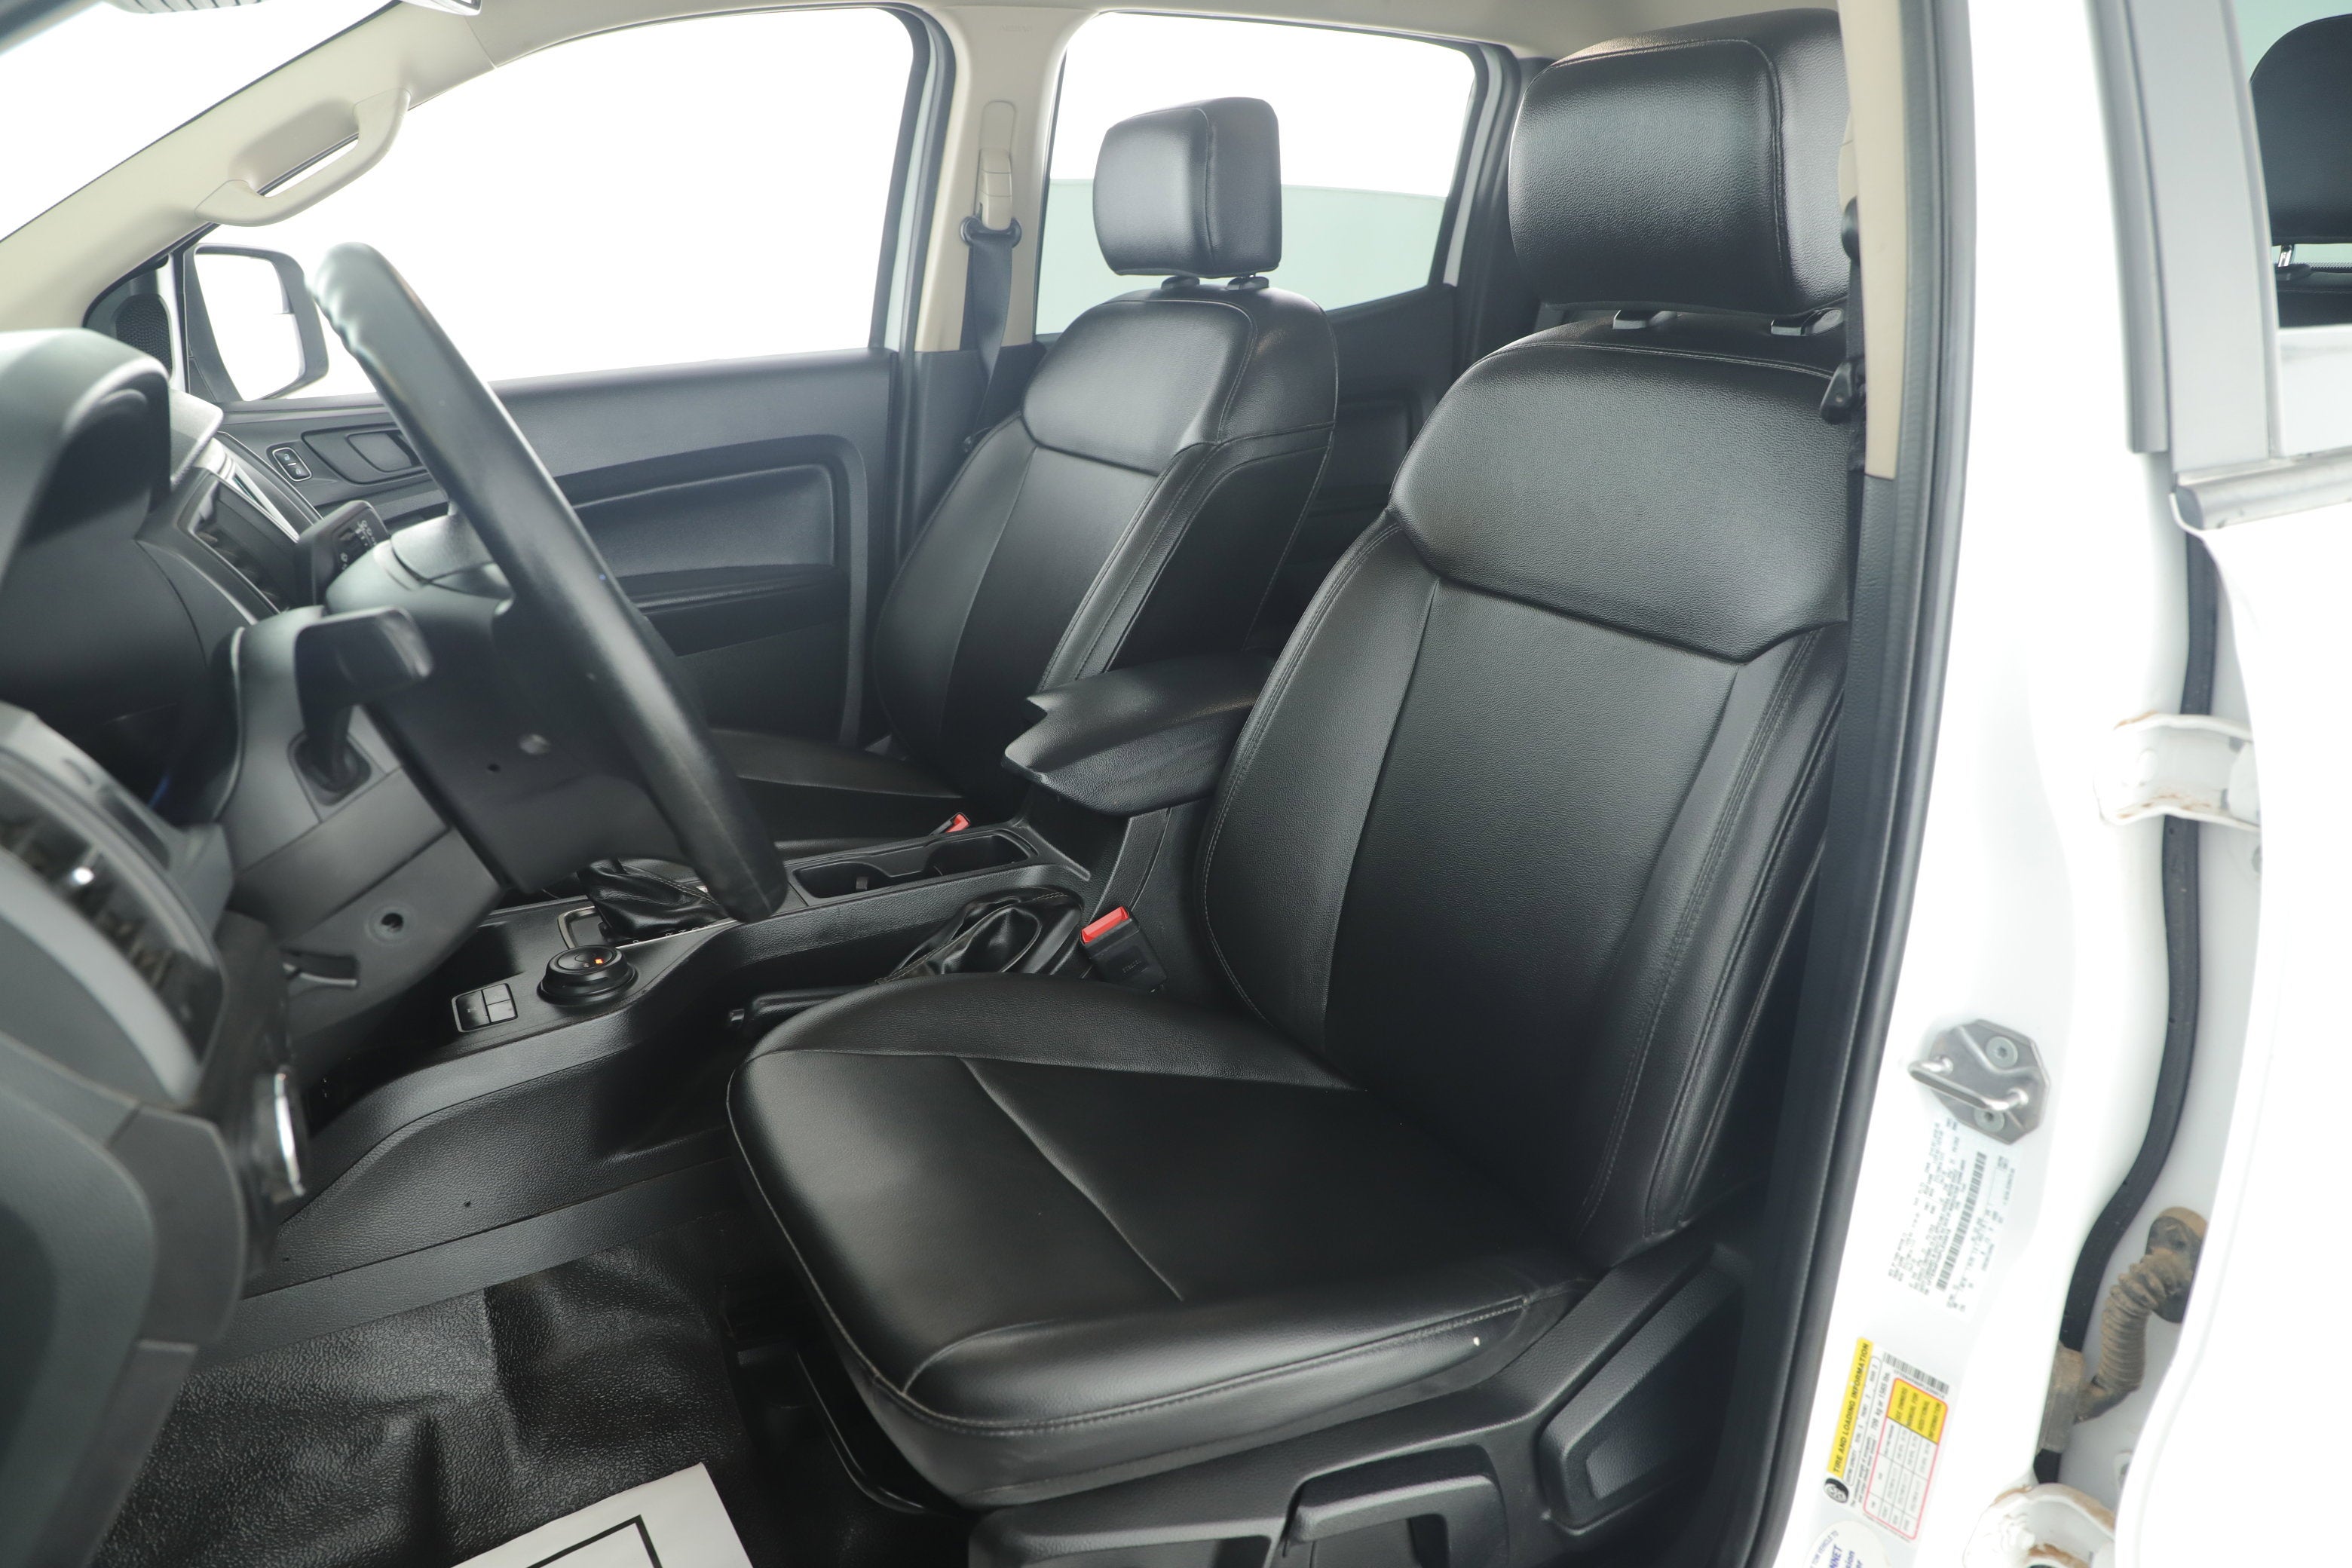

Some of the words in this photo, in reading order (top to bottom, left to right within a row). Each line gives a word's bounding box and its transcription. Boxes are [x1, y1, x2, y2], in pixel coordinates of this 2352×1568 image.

[1834, 1455, 1842, 1473] TIRE
[1839, 1436, 1847, 1453] AND
[1843, 1400, 1856, 1435] LOADING
[1851, 1343, 1870, 1399] INFORMATION
